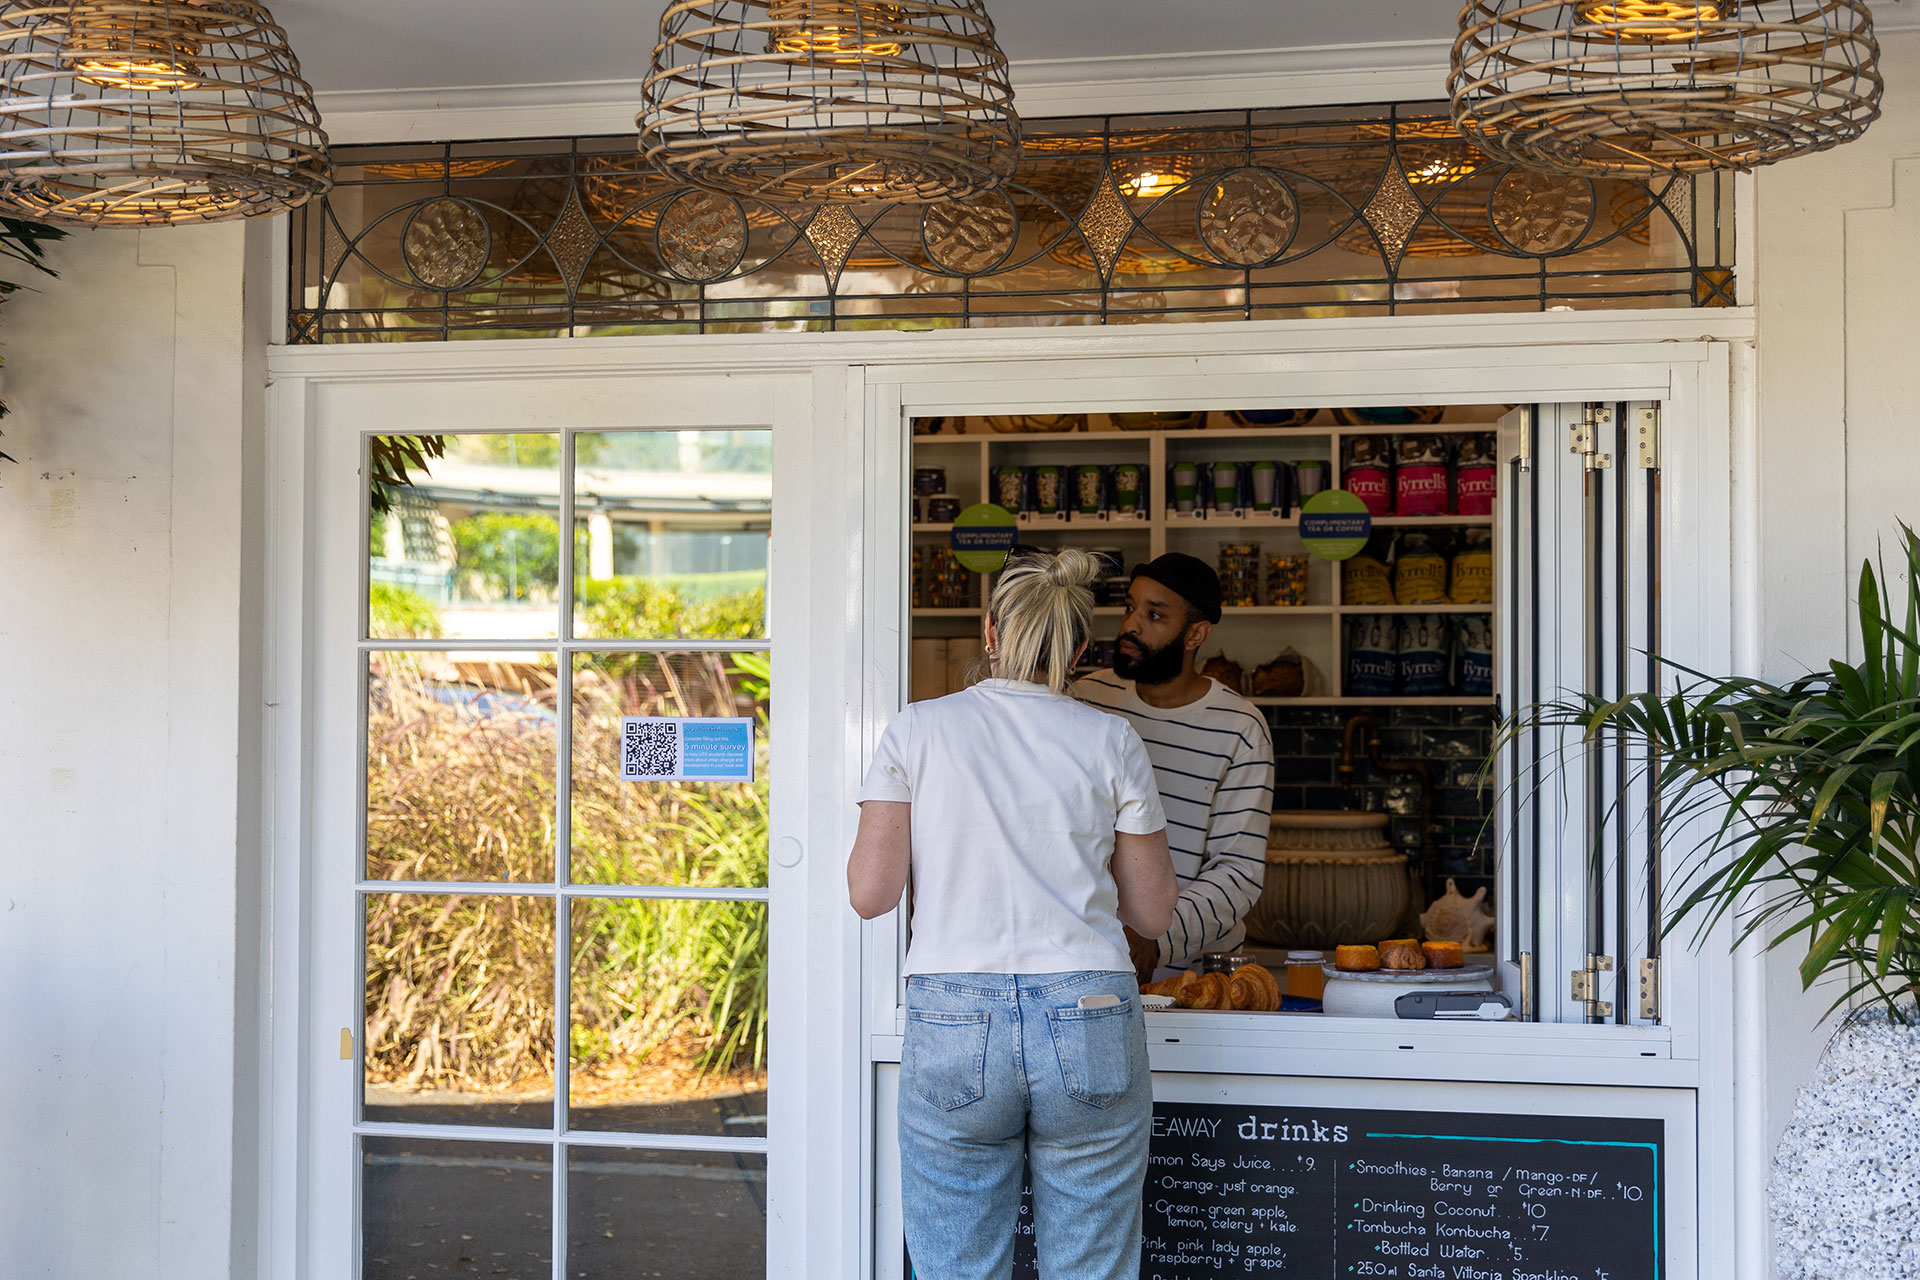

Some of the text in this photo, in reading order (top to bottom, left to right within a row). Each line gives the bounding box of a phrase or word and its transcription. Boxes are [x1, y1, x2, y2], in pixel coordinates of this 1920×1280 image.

[684, 742, 689, 750] 5
[720, 744, 746, 752] survey
[1151, 1115, 1349, 1143] EAWAY drinks
[1149, 1152, 1184, 1166] imon
[1191, 1153, 1226, 1172] Says
[1356, 1159, 1427, 1176] Smoothies
[1443, 1164, 1493, 1179] Banana
[1430, 1178, 1472, 1196] Berry
[1486, 1184, 1503, 1197] or
[1252, 1205, 1288, 1220] apple,
[1362, 1198, 1425, 1219] Drinking
[1434, 1201, 1497, 1217] Coconut
[1168, 1216, 1208, 1231] lemon,
[1212, 1218, 1254, 1234] celery
[1354, 1219, 1426, 1235] Tombucha
[1436, 1222, 1511, 1239] Kombucha
[1177, 1238, 1204, 1254] pink
[1211, 1239, 1240, 1257] lady
[1381, 1240, 1430, 1257] Bottled
[1440, 1242, 1485, 1259] Water
[1150, 1252, 1222, 1269] raspberry
[1407, 1262, 1446, 1279] Santa
[1452, 1265, 1503, 1280] Vittoria
